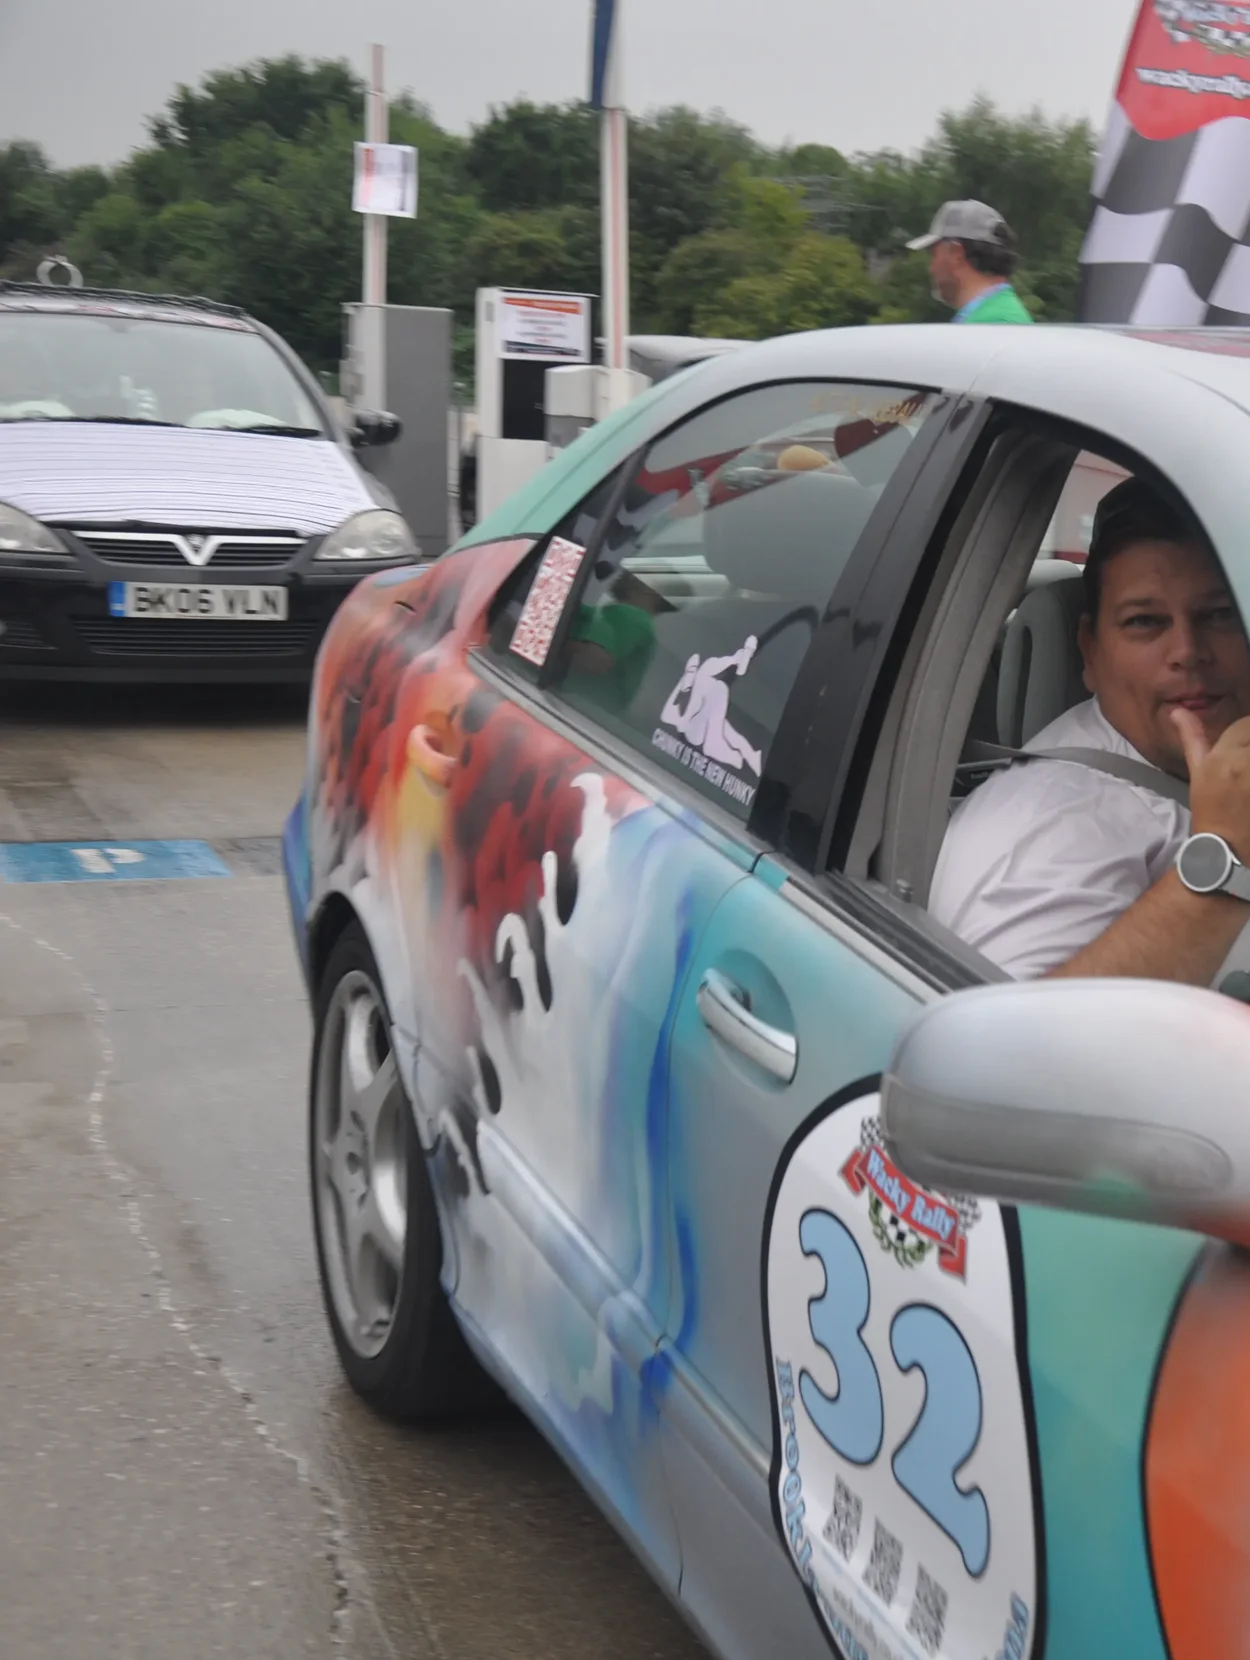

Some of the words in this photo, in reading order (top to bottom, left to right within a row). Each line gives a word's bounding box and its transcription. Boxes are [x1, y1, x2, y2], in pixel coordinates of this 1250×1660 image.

[689, 751, 709, 777] THE
[703, 761, 728, 788] NEW
[722, 772, 756, 806] HUNKY
[866, 1148, 911, 1216] Wacky
[911, 1193, 956, 1241] Rally
[798, 1206, 991, 1579] 32
